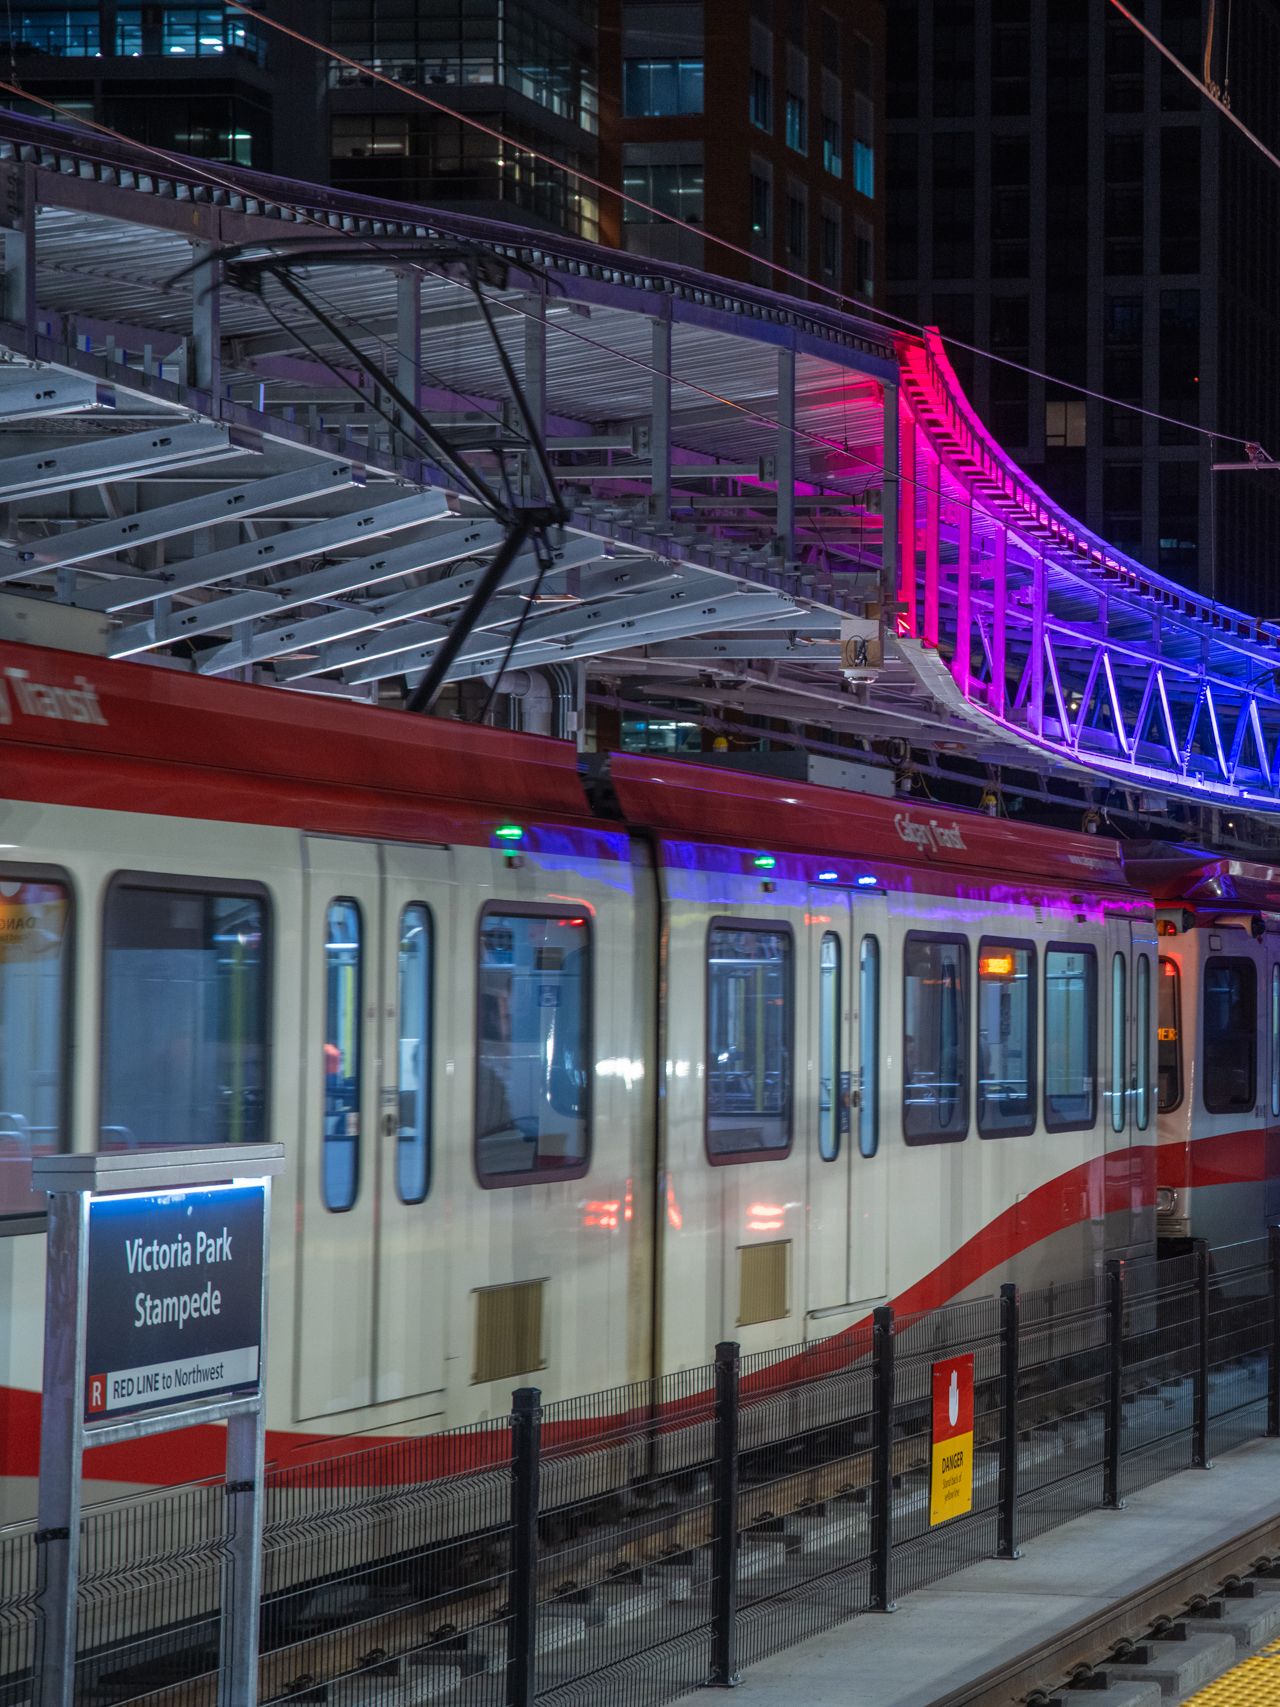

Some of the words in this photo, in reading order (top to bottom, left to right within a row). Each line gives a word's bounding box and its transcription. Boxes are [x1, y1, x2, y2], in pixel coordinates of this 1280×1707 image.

[4, 667, 109, 726] Transit
[125, 1233, 192, 1274] Victoria
[196, 1227, 232, 1265] Park
[134, 1281, 221, 1330] Stampede
[91, 1381, 102, 1407] R
[113, 1378, 135, 1399] RED
[136, 1372, 160, 1395] LINE
[162, 1375, 172, 1390] to
[174, 1363, 224, 1388] Northwest
[942, 1451, 963, 1474] DANGER
